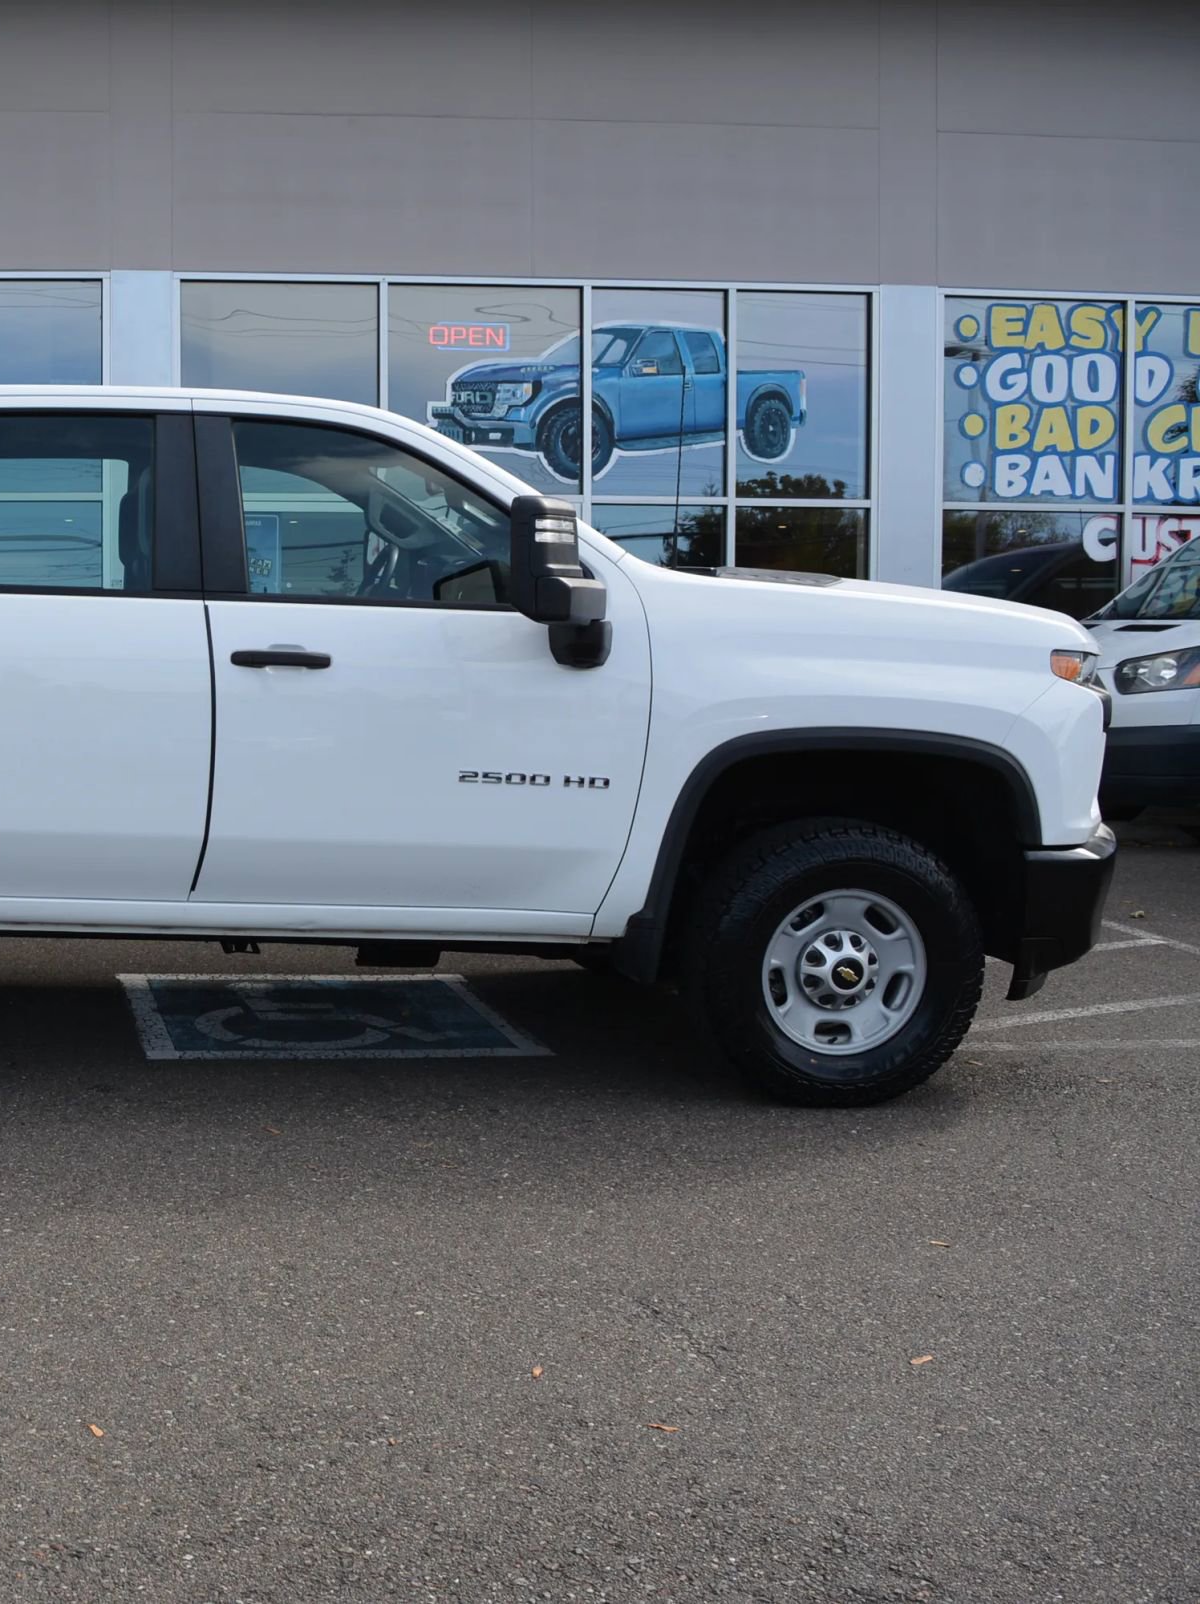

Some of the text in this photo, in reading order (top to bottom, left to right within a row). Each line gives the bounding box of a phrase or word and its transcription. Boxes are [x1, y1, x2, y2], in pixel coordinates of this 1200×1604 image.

[428, 325, 505, 347] OPEN
[987, 303, 1161, 352] EASY
[984, 350, 1173, 406] GOOD
[993, 403, 1117, 453] BAD
[993, 453, 1200, 499] BANKR
[458, 770, 610, 790] 2500 HD
